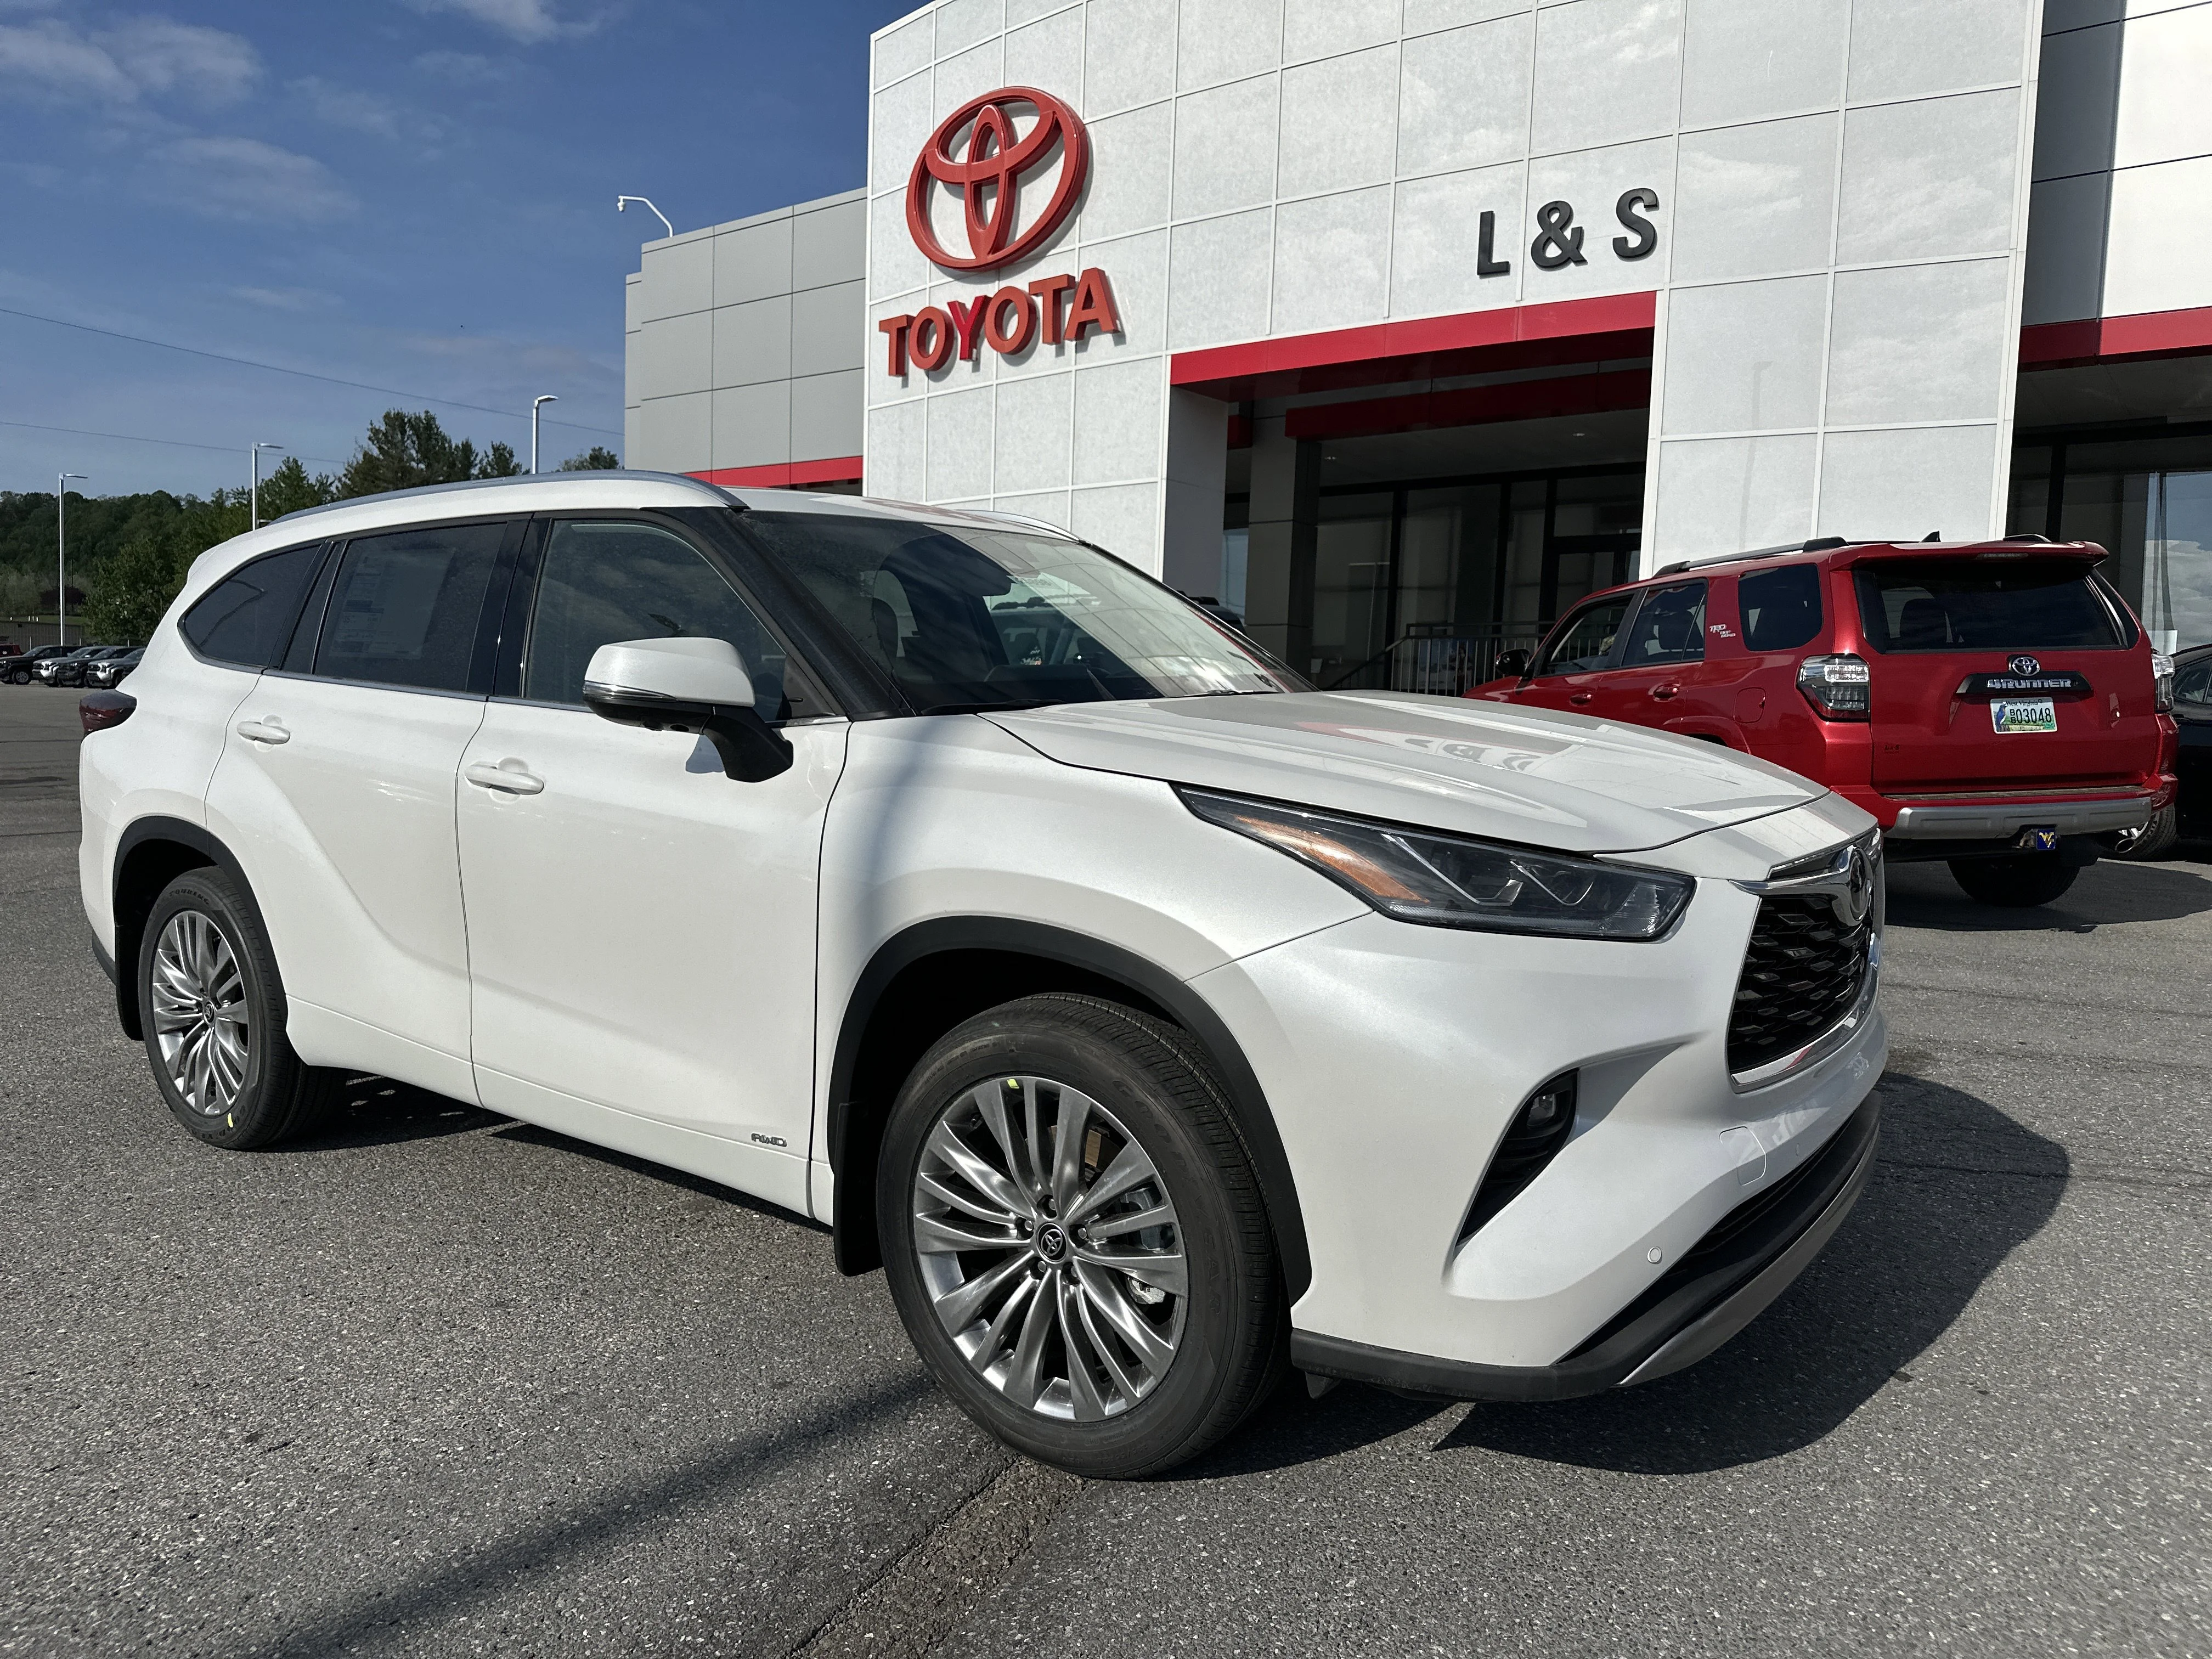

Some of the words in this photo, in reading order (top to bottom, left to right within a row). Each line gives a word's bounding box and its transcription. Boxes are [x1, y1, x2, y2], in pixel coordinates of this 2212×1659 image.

[1477, 211, 1510, 275] L
[1531, 200, 1587, 268] &
[1612, 188, 1658, 259] S
[879, 267, 1121, 376] TOYOTA
[1709, 624, 1726, 633] TRD
[1987, 679, 2072, 689] 4RUNNER
[751, 1133, 787, 1147] AWD
